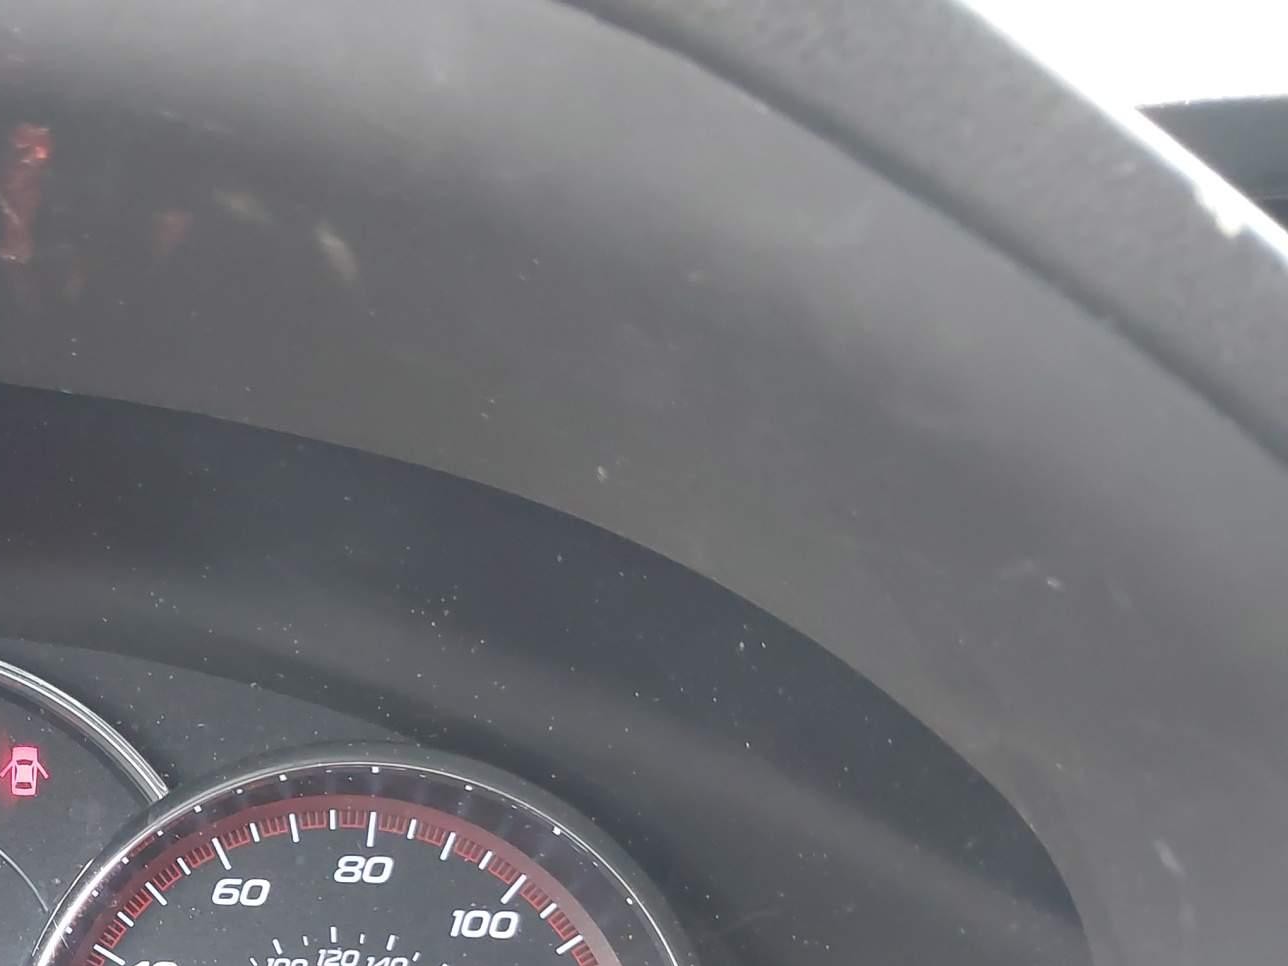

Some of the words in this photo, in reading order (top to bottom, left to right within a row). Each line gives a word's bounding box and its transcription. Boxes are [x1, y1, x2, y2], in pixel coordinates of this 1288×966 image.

[334, 856, 393, 883] 80
[212, 879, 270, 906] 60
[451, 910, 519, 938] 100
